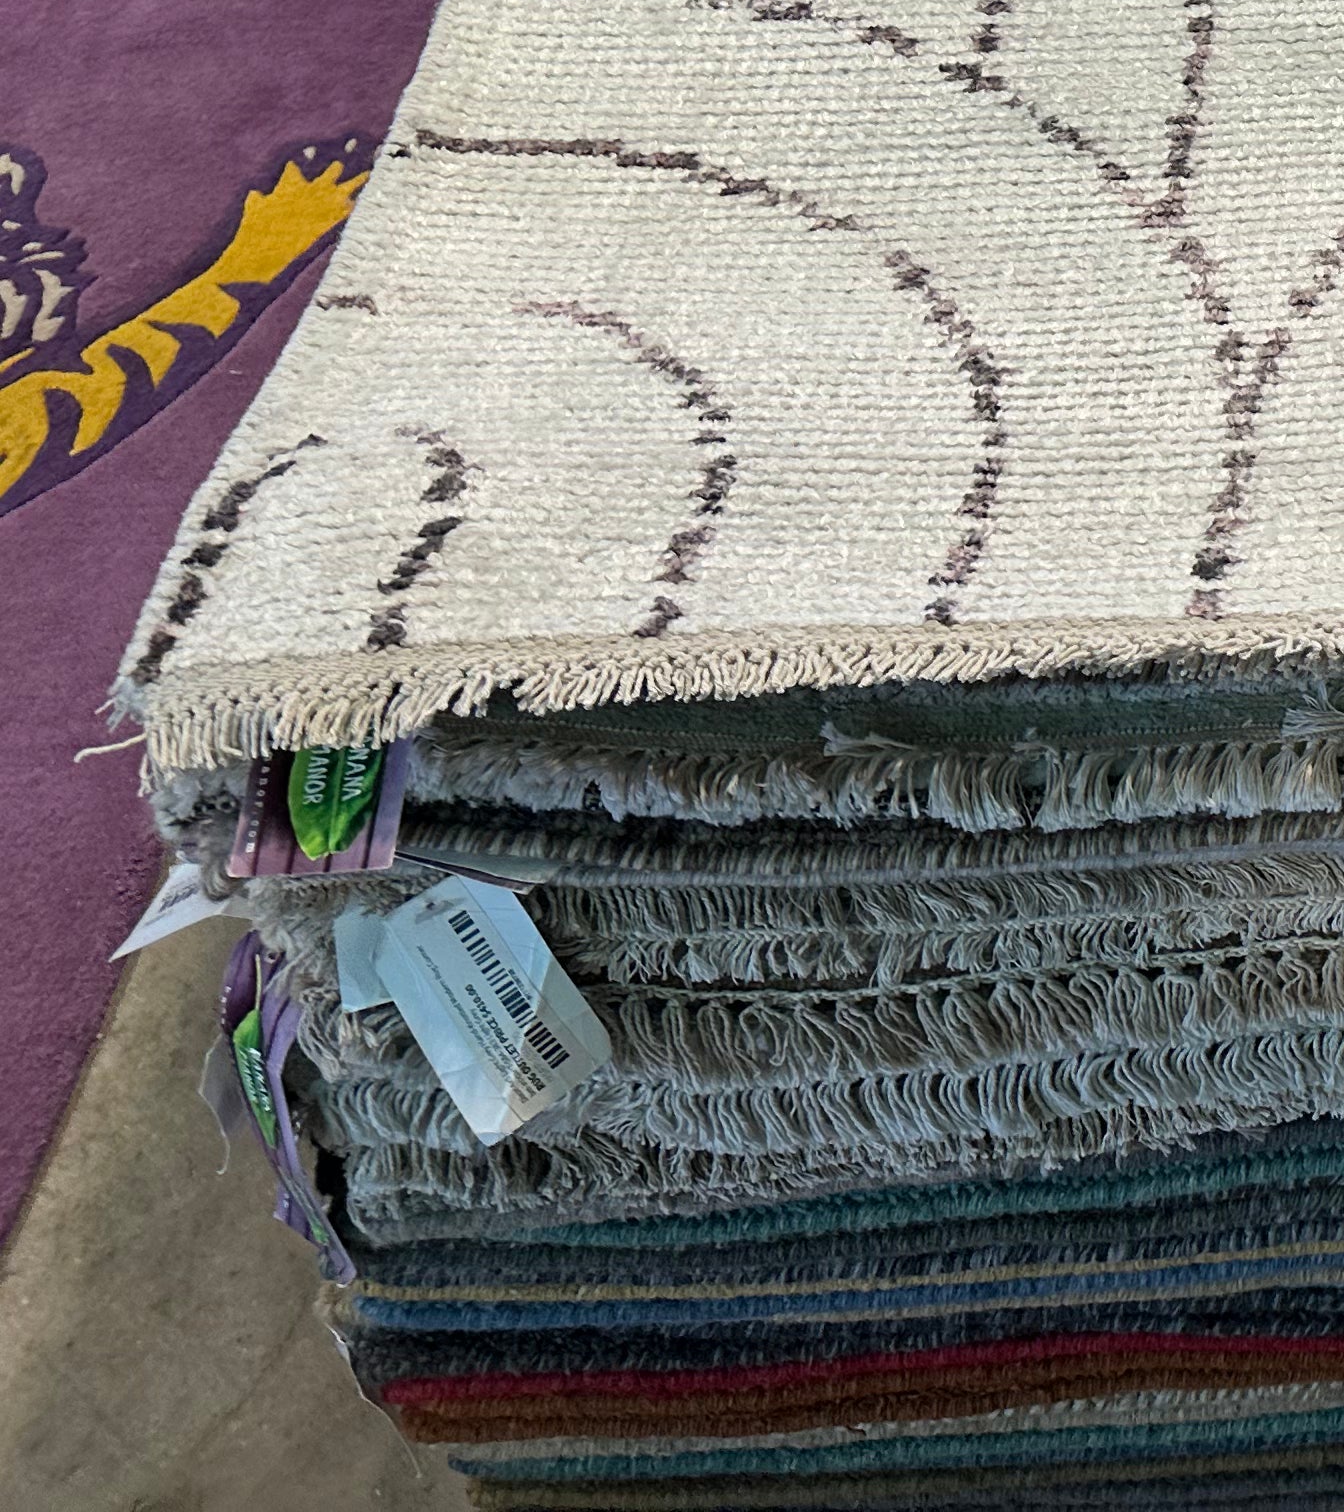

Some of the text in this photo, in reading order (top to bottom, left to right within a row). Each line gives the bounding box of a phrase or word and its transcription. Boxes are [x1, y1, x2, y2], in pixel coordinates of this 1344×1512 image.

[341, 736, 371, 802] NANA
[465, 983, 492, 1017] $410.00
[485, 1016, 508, 1044] PRICE
[503, 1040, 532, 1076] OUTLET
[526, 1070, 545, 1092] RUG
